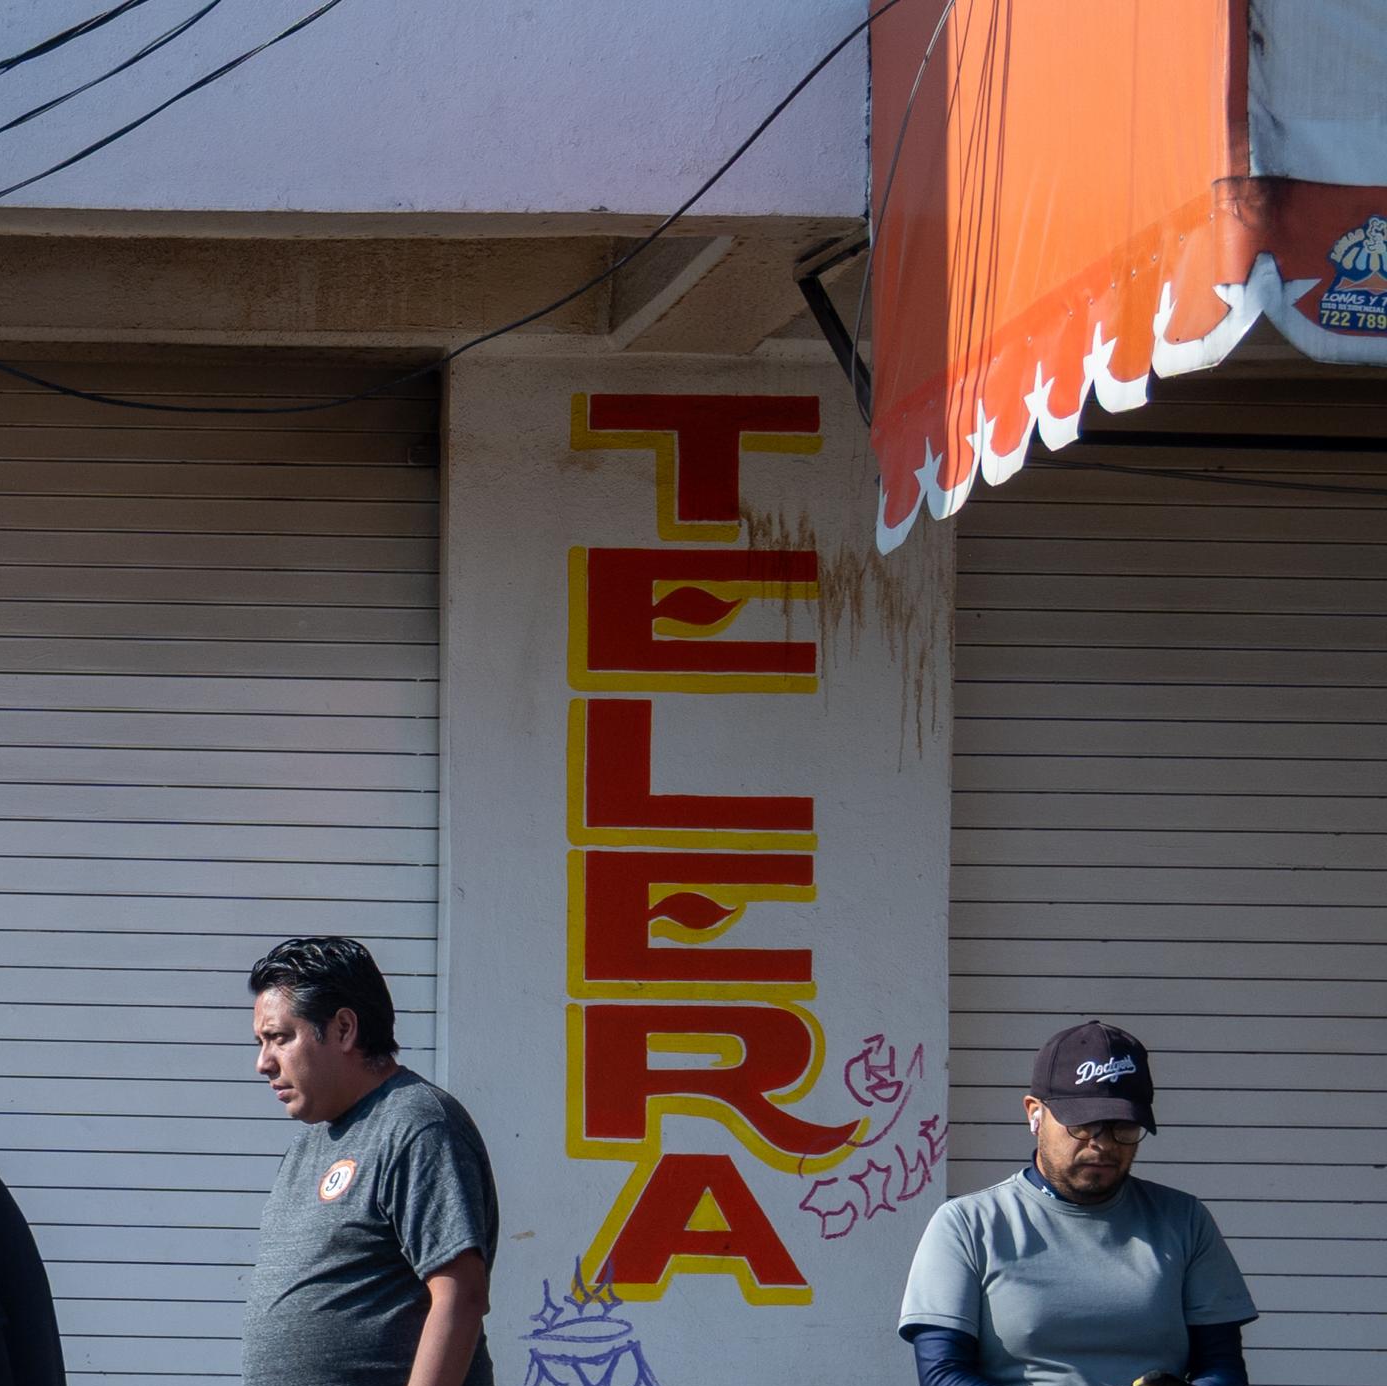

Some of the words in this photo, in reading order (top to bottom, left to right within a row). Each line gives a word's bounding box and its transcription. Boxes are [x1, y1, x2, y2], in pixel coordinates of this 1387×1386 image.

[1322, 293, 1365, 305] LONAS
[1369, 296, 1379, 306] Y
[1321, 310, 1350, 327] 722
[566, 393, 869, 1305] TELERA
[1075, 1055, 1136, 1084] Dodgers
